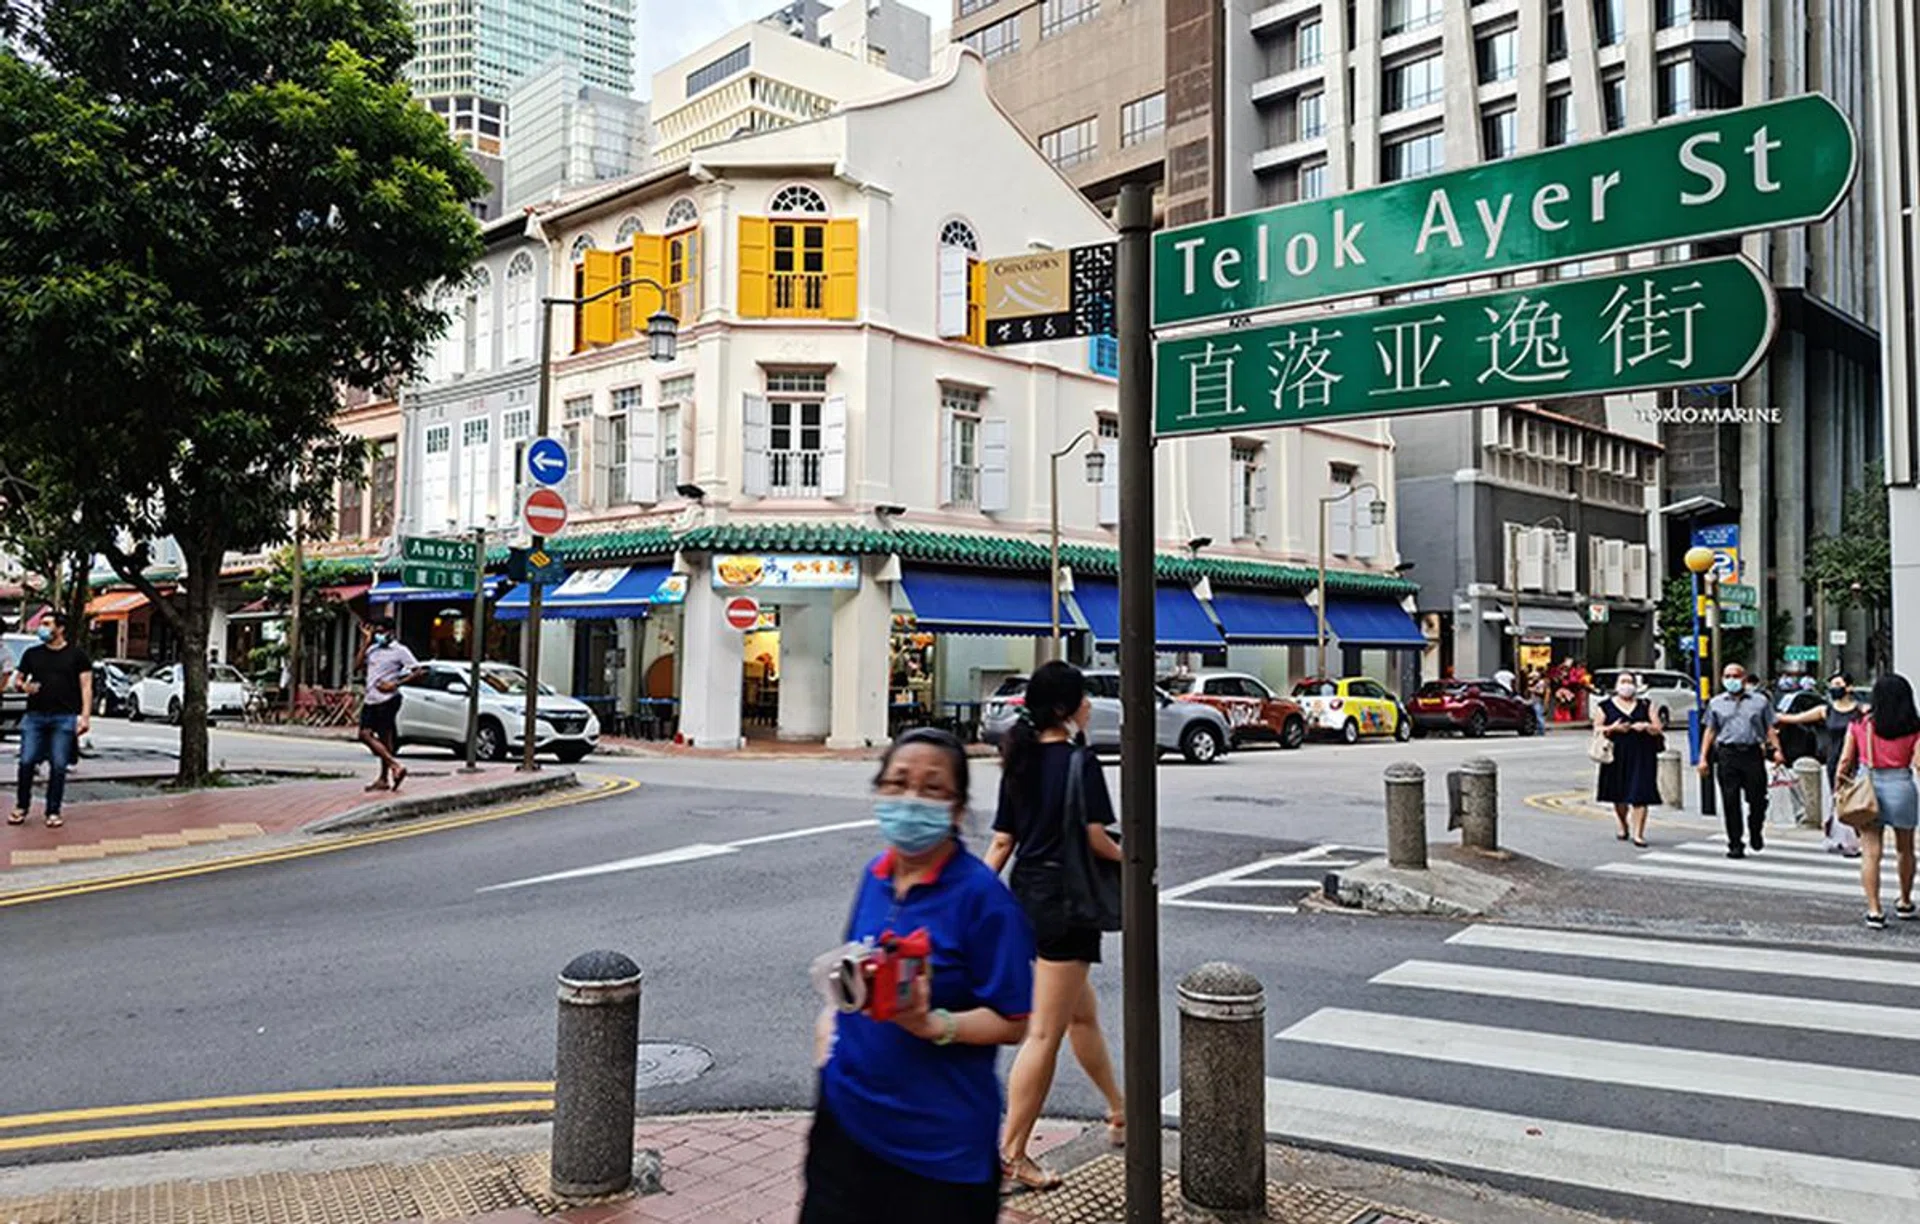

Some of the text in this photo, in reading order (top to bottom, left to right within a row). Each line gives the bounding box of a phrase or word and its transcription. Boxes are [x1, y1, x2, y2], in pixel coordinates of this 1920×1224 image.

[1174, 126, 1781, 295] Telok Ayer St
[1175, 278, 1706, 422] 直落亚逸街
[1700, 407, 1783, 424] MARINE
[411, 541, 474, 561] Amoy St
